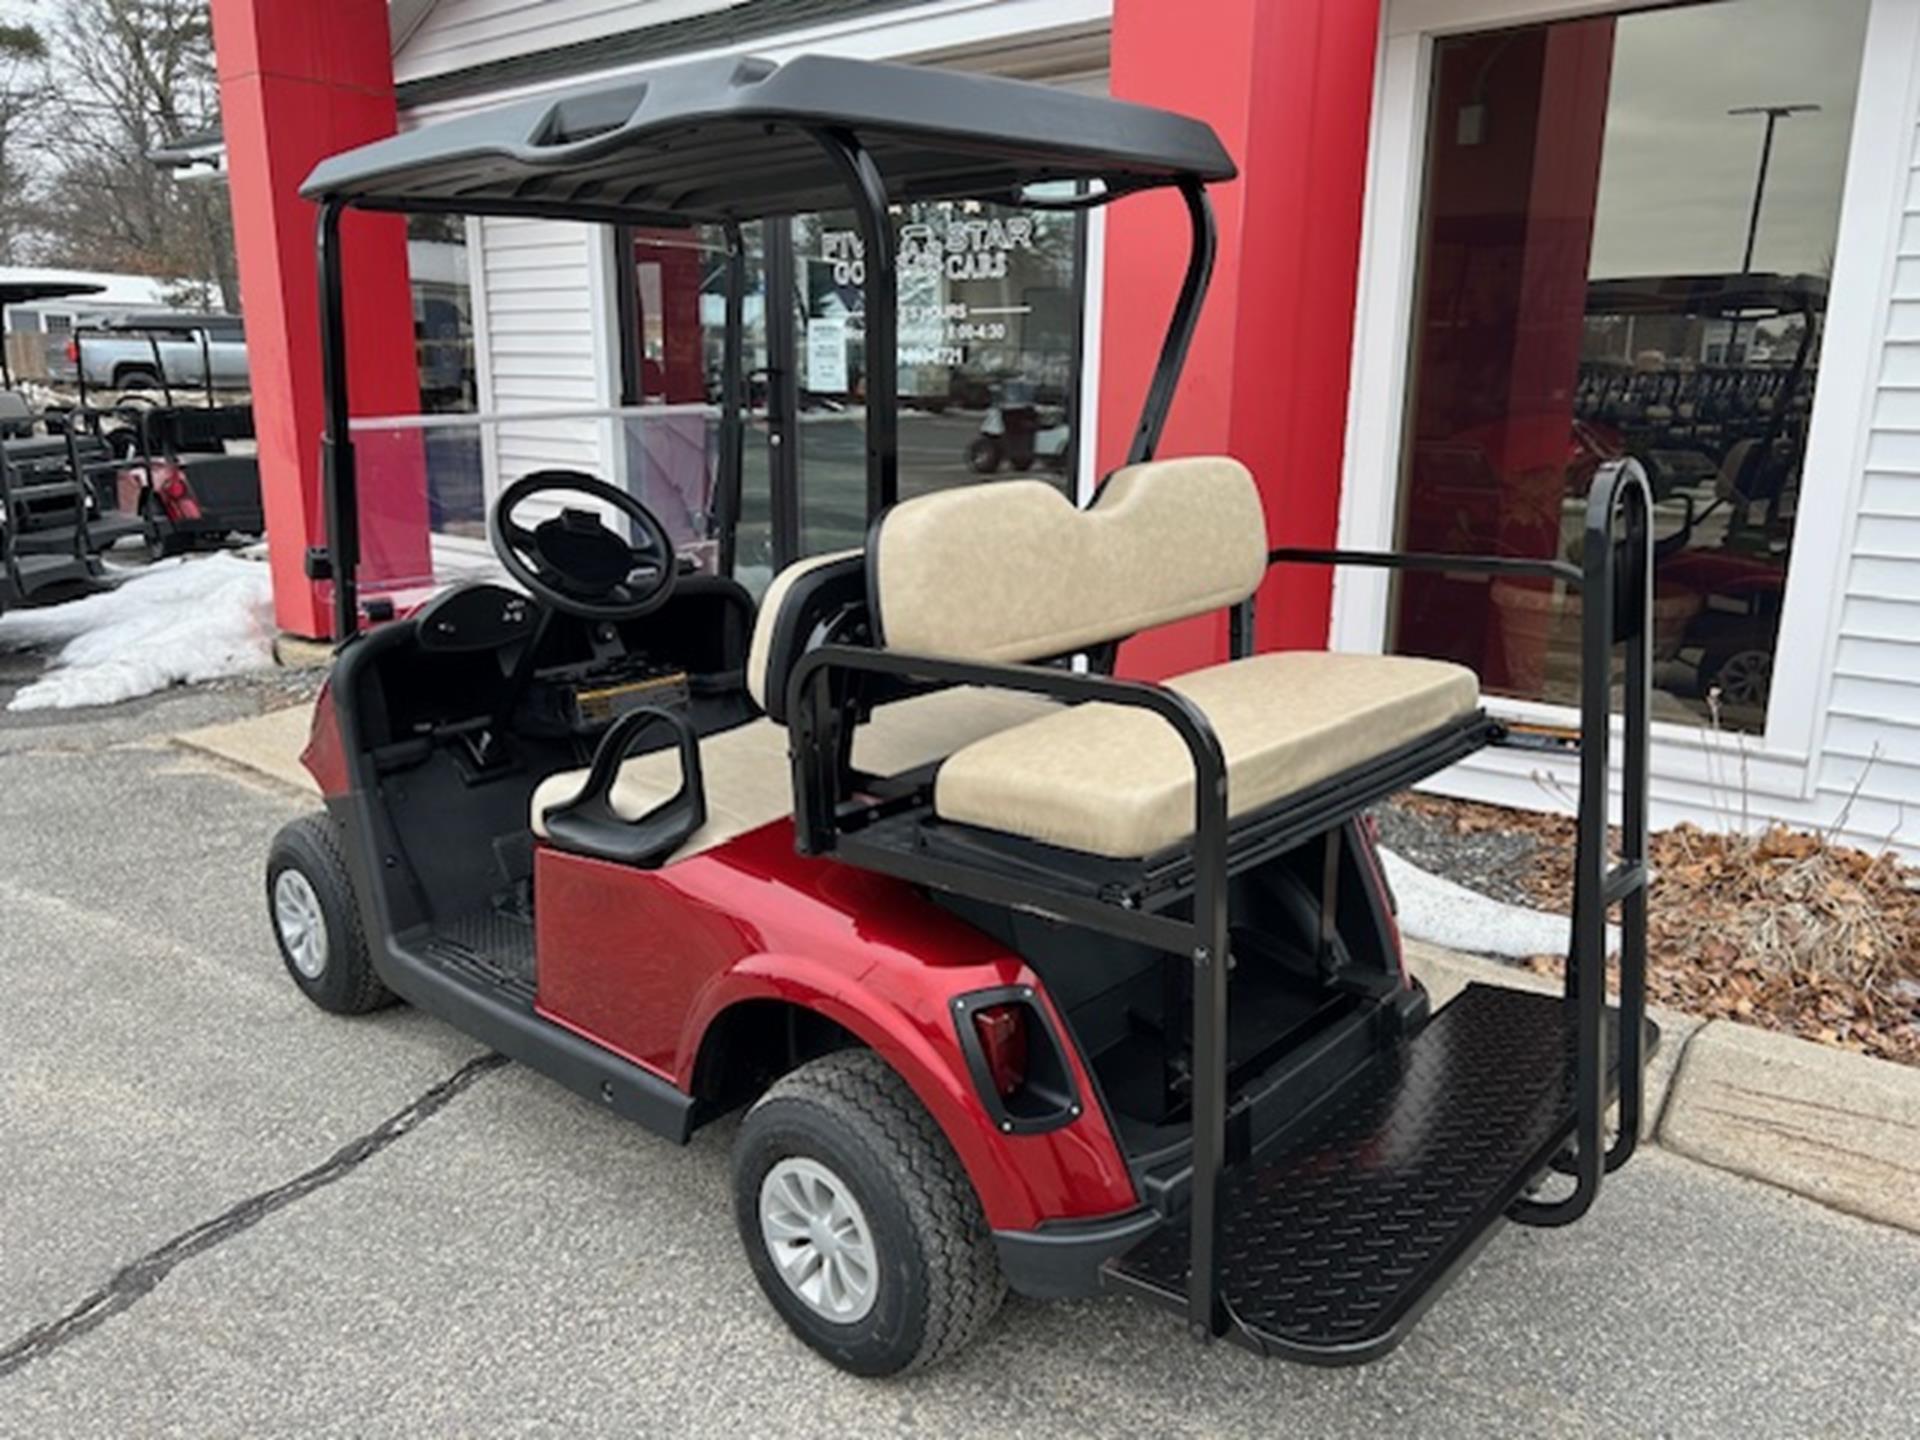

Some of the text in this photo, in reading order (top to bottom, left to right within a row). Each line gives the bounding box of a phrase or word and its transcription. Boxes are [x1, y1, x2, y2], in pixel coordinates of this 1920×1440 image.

[821, 217, 1033, 261] FIV STAR
[834, 260, 865, 286] GO
